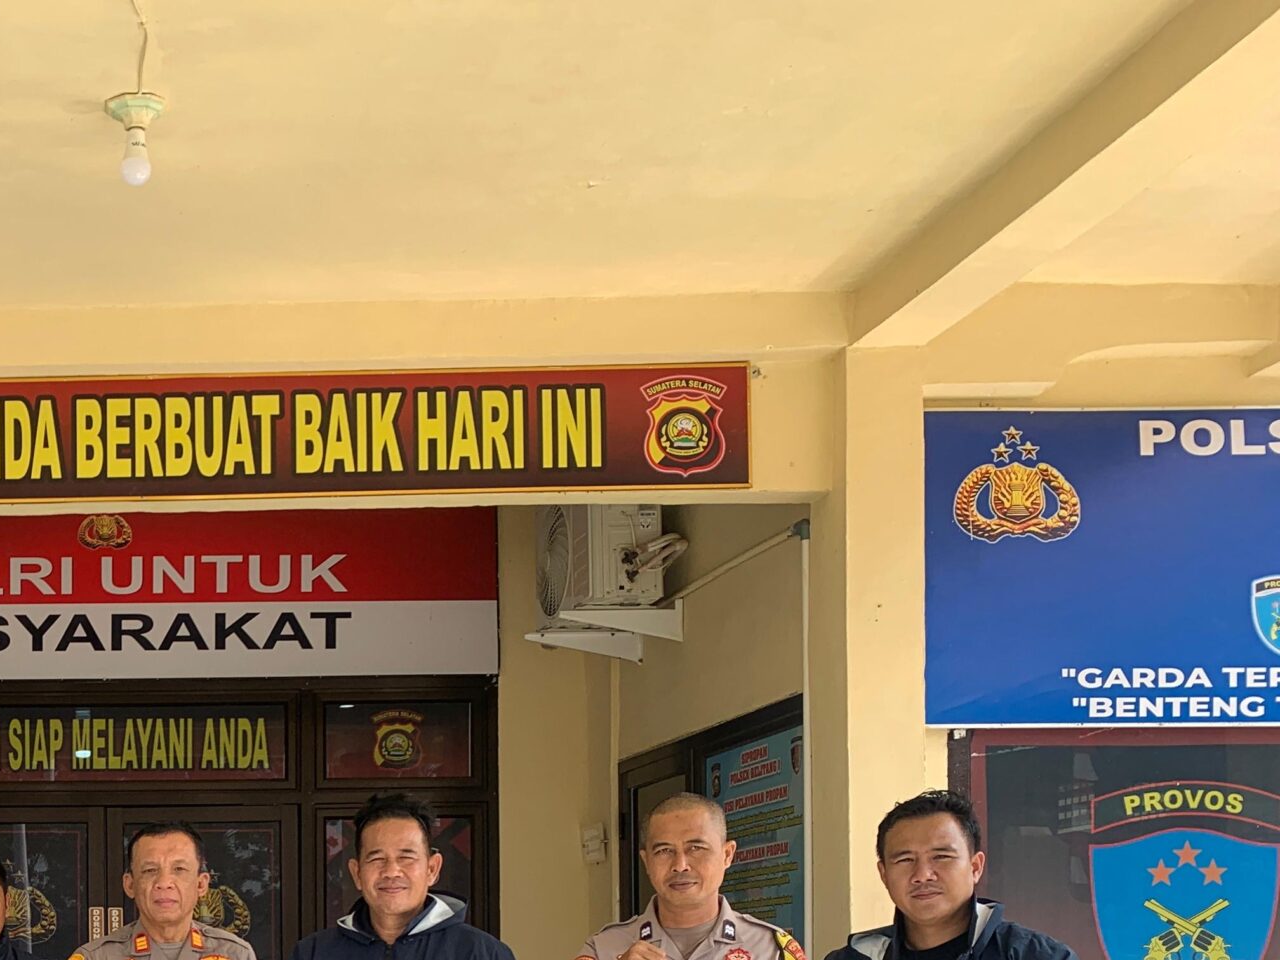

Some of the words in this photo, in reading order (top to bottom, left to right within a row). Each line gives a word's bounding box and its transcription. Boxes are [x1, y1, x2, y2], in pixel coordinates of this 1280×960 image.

[646, 380, 687, 396] SUMATERA
[688, 380, 721, 395] SELATAN
[76, 393, 281, 479] BERBUAT
[295, 391, 404, 475] BAIK
[417, 389, 526, 471] HARI
[541, 387, 603, 469] INI
[100, 553, 349, 596] UNTUK
[1061, 667, 1214, 689] "GARDA
[1072, 696, 1266, 718] "BENTENG
[8, 718, 64, 770] SIAP
[72, 718, 194, 770] MELAYANI
[201, 717, 270, 769] ANDA
[1124, 789, 1244, 816] PROVOS
[92, 909, 101, 940] DORON
